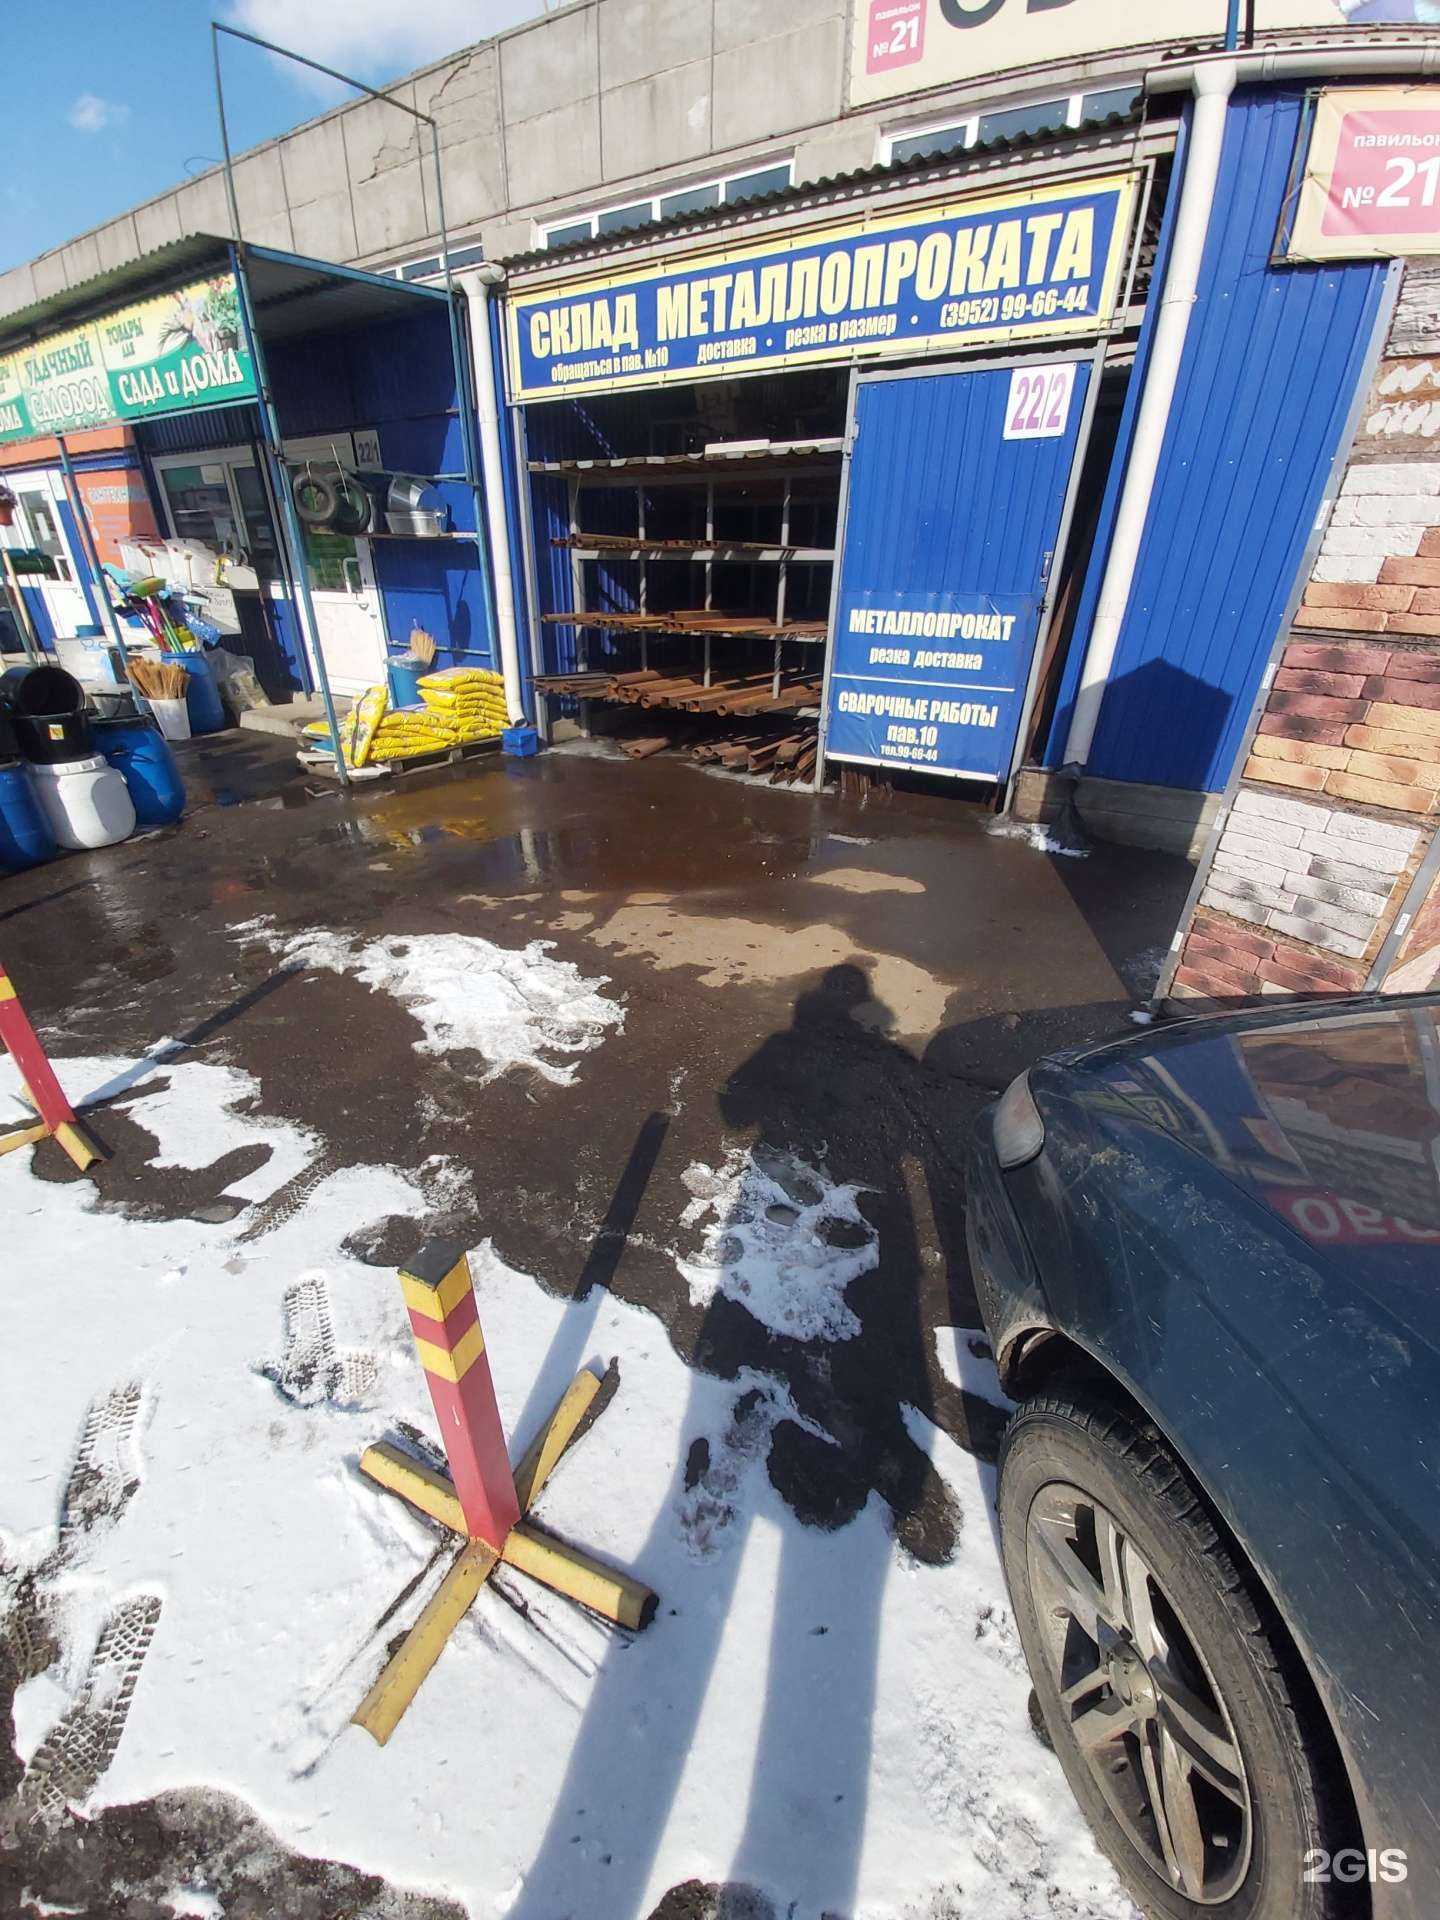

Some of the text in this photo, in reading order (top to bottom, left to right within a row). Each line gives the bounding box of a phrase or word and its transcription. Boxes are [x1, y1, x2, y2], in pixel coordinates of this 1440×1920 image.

[530, 207, 1095, 359] СКЛАД МЕТАЛЛОПРОКАТА
[697, 284, 1090, 364] доставка резка в размер (3952) 99-66-44
[24, 333, 94, 386] УДАЧНЫЙ
[118, 366, 166, 407] САДА
[180, 347, 244, 398] ДОМА
[551, 346, 669, 382] обращаться в пав. №10
[1010, 372, 1067, 431] 22/2
[849, 608, 1016, 641] МЕТАЛЛОПРОКАТ
[869, 647, 983, 671] резка доставка
[838, 691, 998, 728] СВАРОЧНЫЕ РАБОТЫ
[886, 725, 938, 747] пав.10
